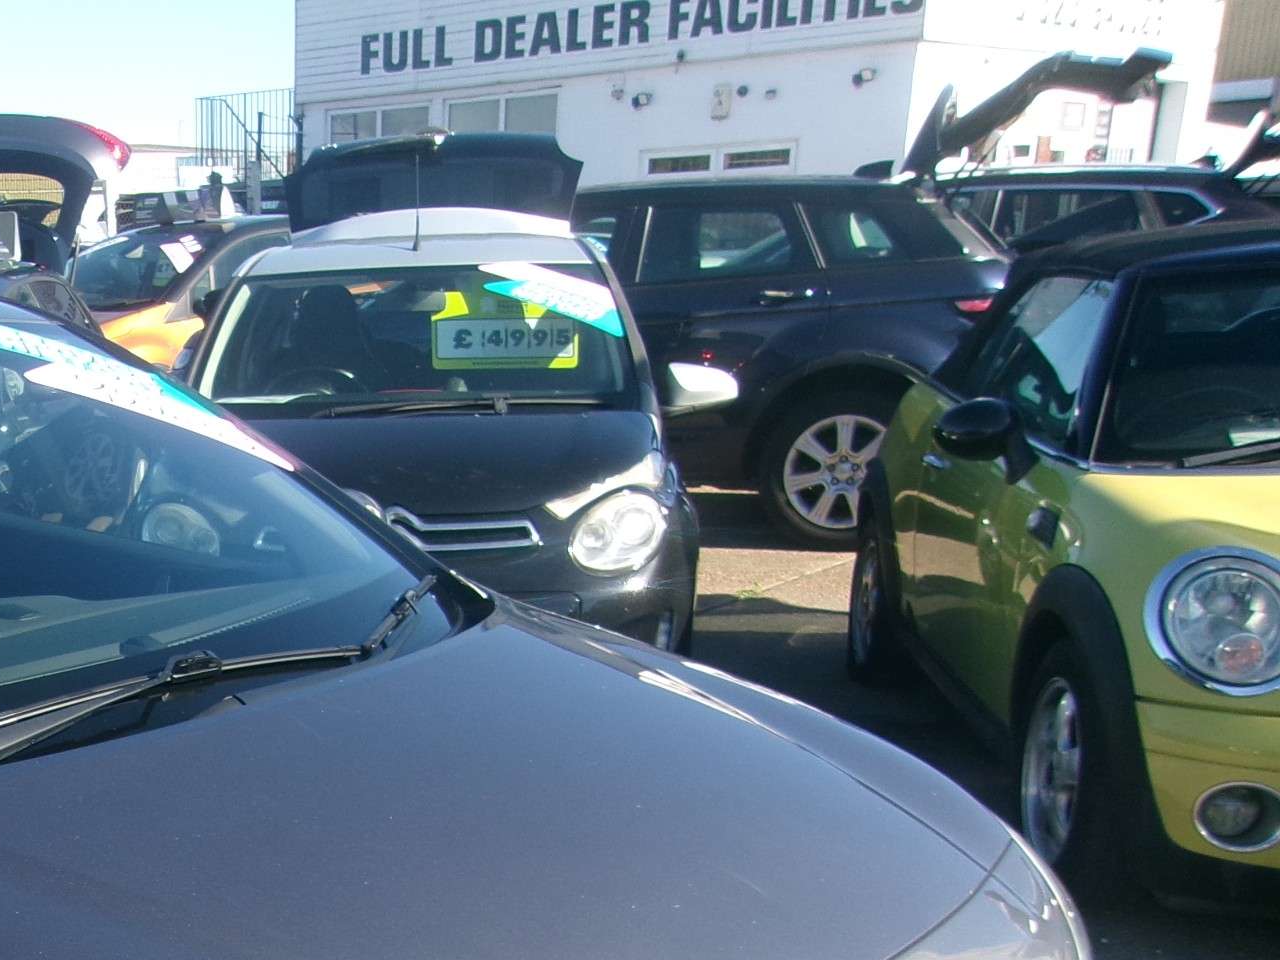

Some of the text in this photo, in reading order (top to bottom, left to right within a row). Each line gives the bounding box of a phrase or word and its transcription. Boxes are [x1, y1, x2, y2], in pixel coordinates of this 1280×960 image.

[360, 0, 922, 75] FULL DEALER FACILI
